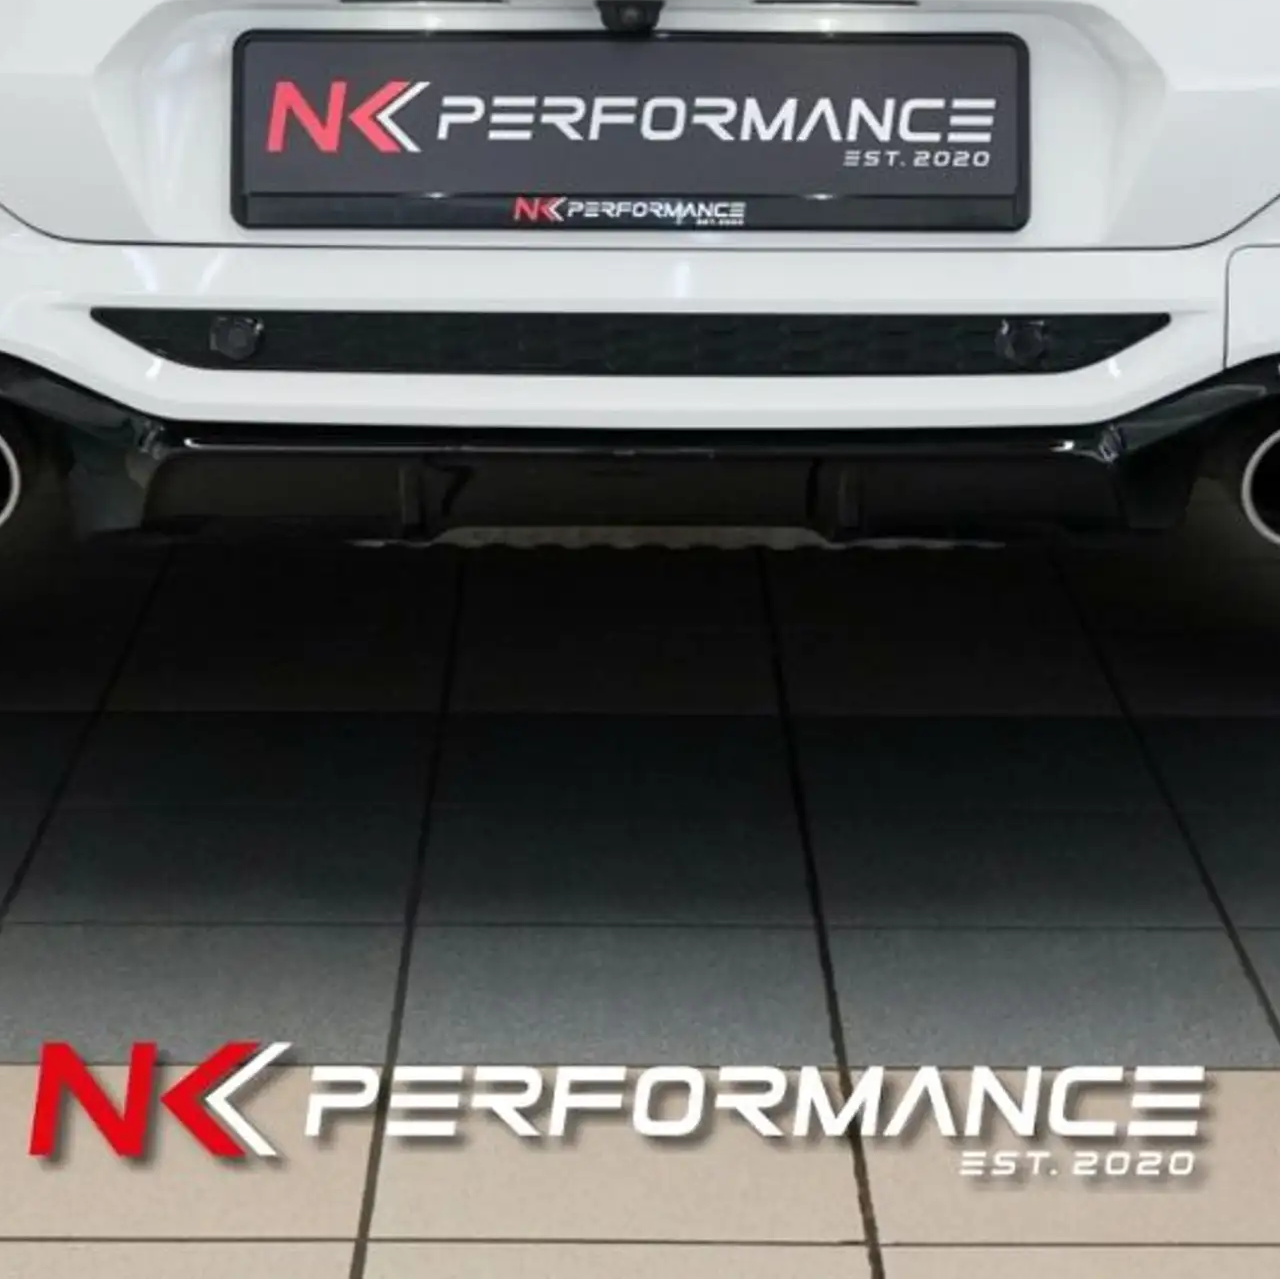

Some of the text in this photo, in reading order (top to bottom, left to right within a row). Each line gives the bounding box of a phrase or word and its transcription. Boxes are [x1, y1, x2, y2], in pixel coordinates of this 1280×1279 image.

[266, 80, 997, 153] NK PERFORMANCE
[843, 150, 991, 168] EST. 2020
[514, 196, 746, 221] NK PERFORMANCE
